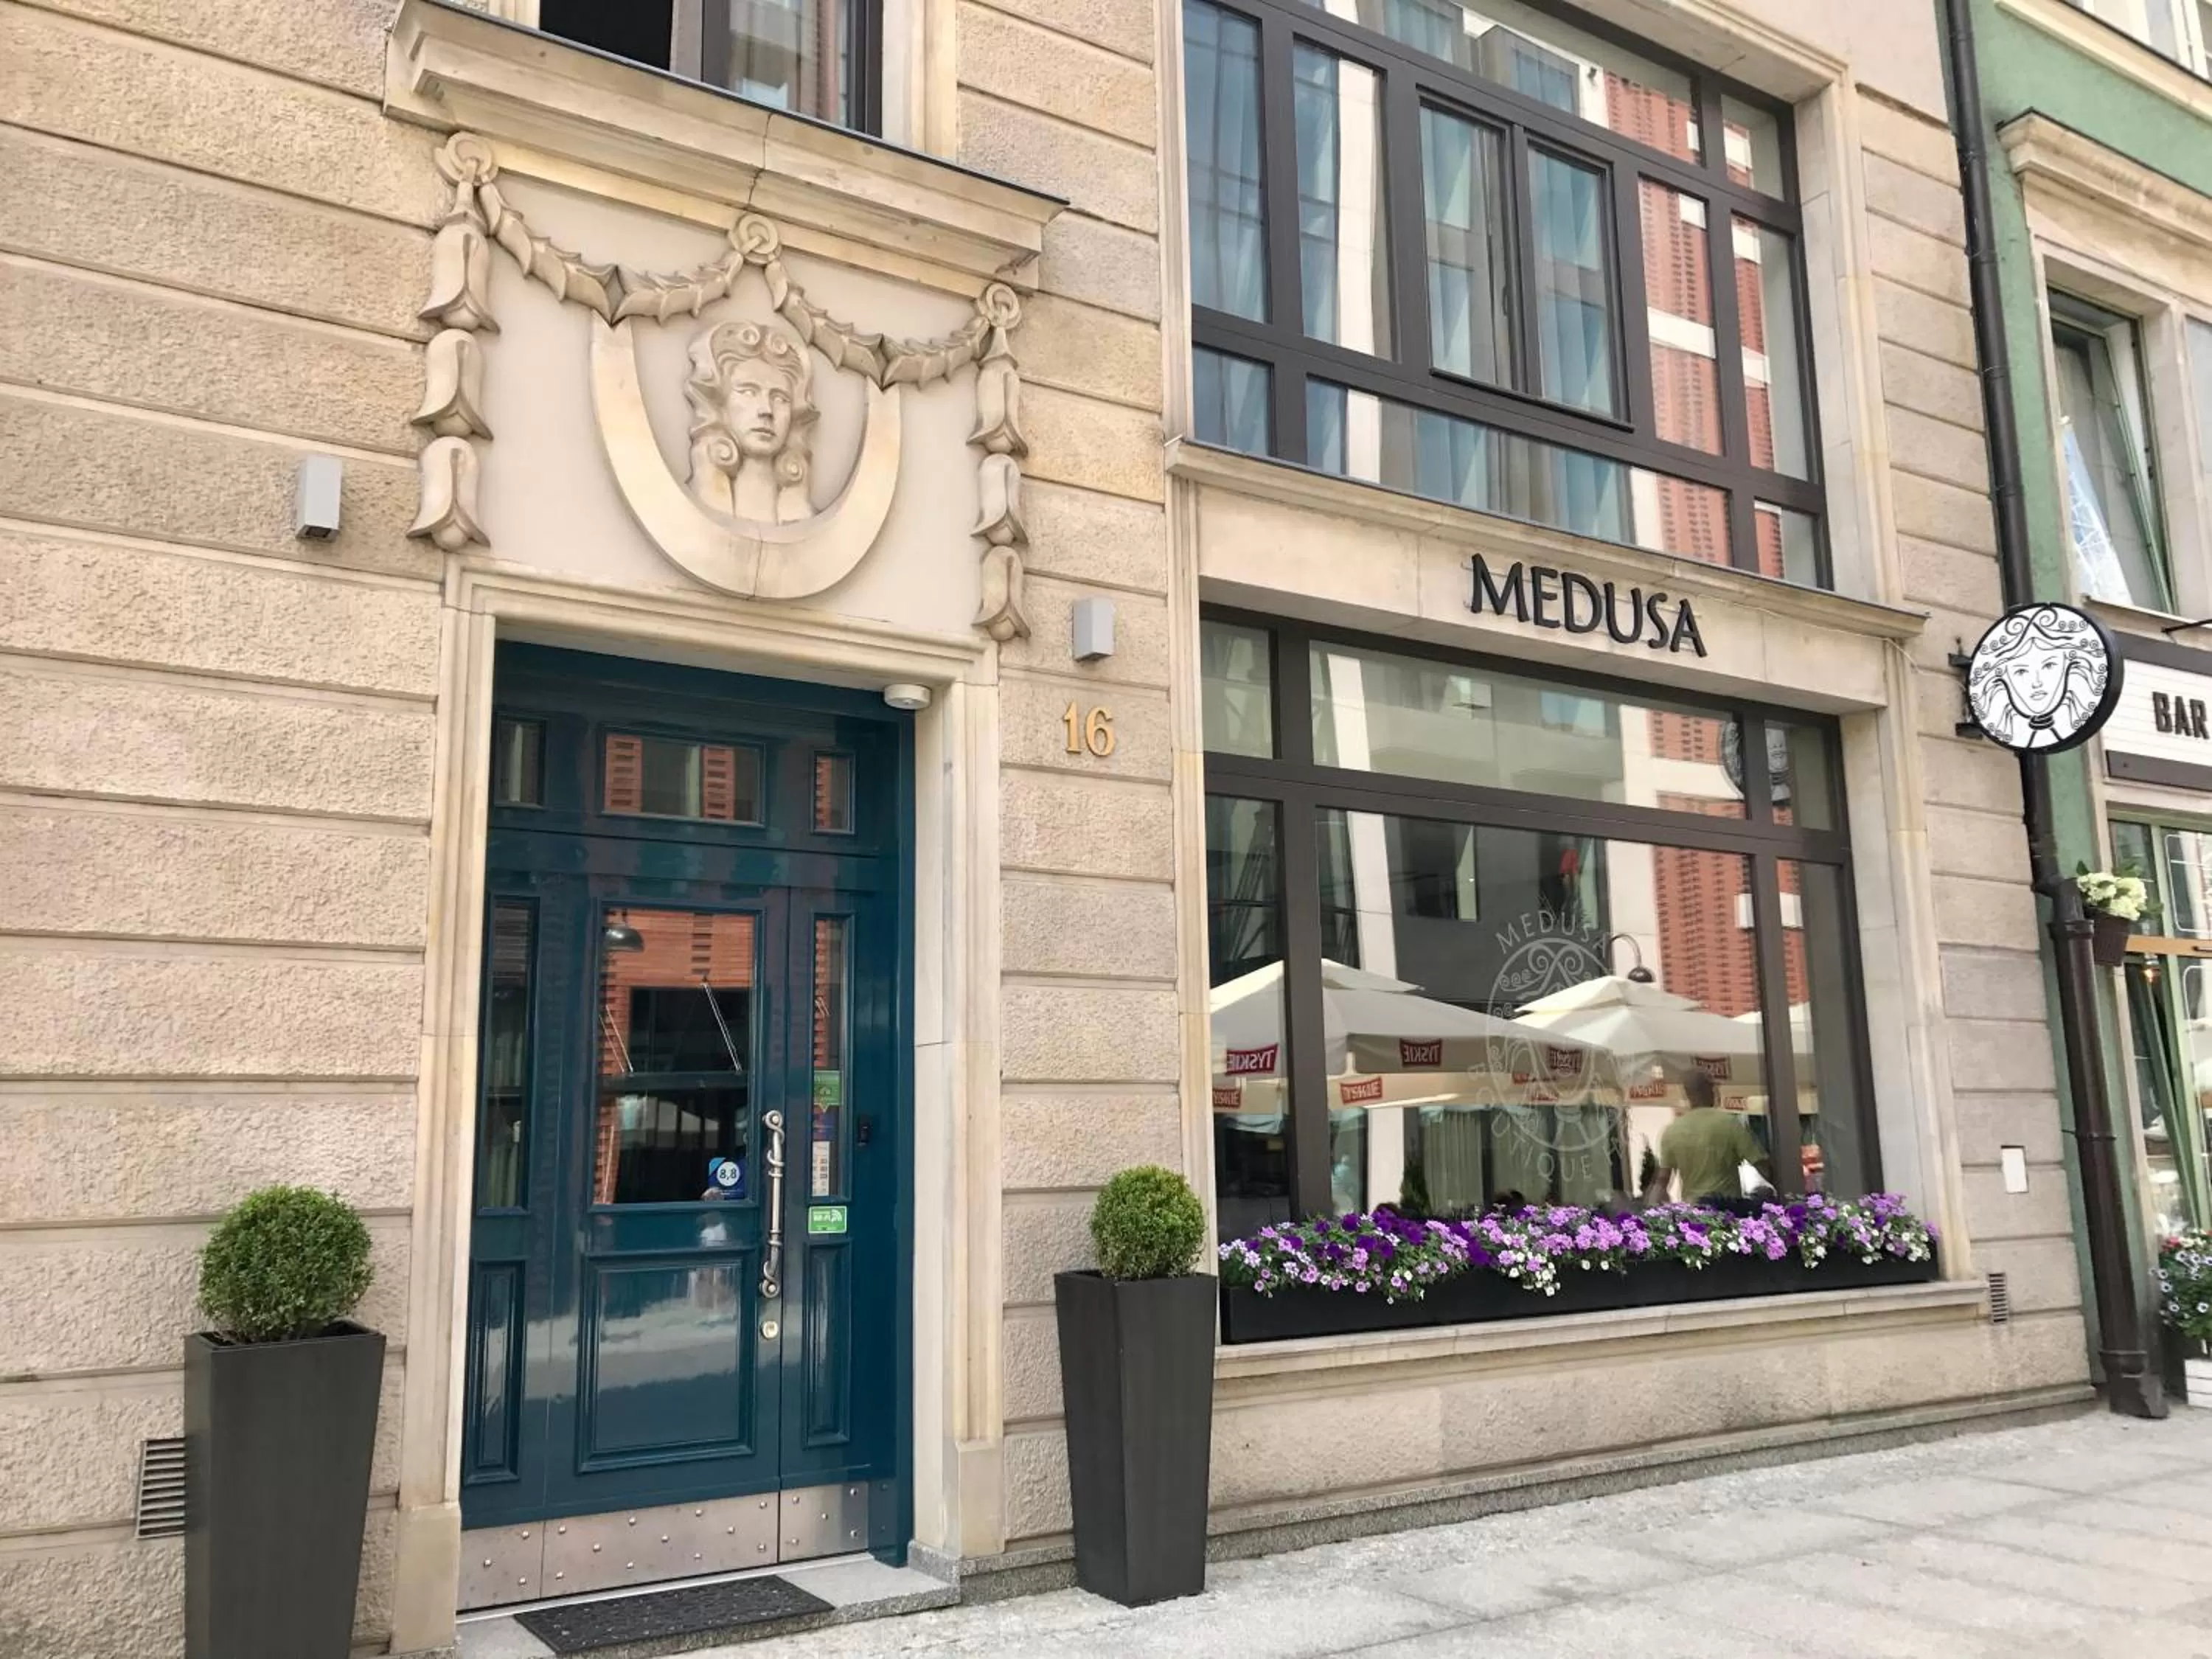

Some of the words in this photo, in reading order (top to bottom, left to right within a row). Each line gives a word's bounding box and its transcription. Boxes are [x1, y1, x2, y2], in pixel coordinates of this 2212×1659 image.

[1470, 553, 1708, 658] MEDUSA
[1062, 701, 1115, 757] 16
[2152, 691, 2210, 740] BAR
[1495, 909, 1607, 959] MEDUSA
[719, 1168, 737, 1180] 8,8
